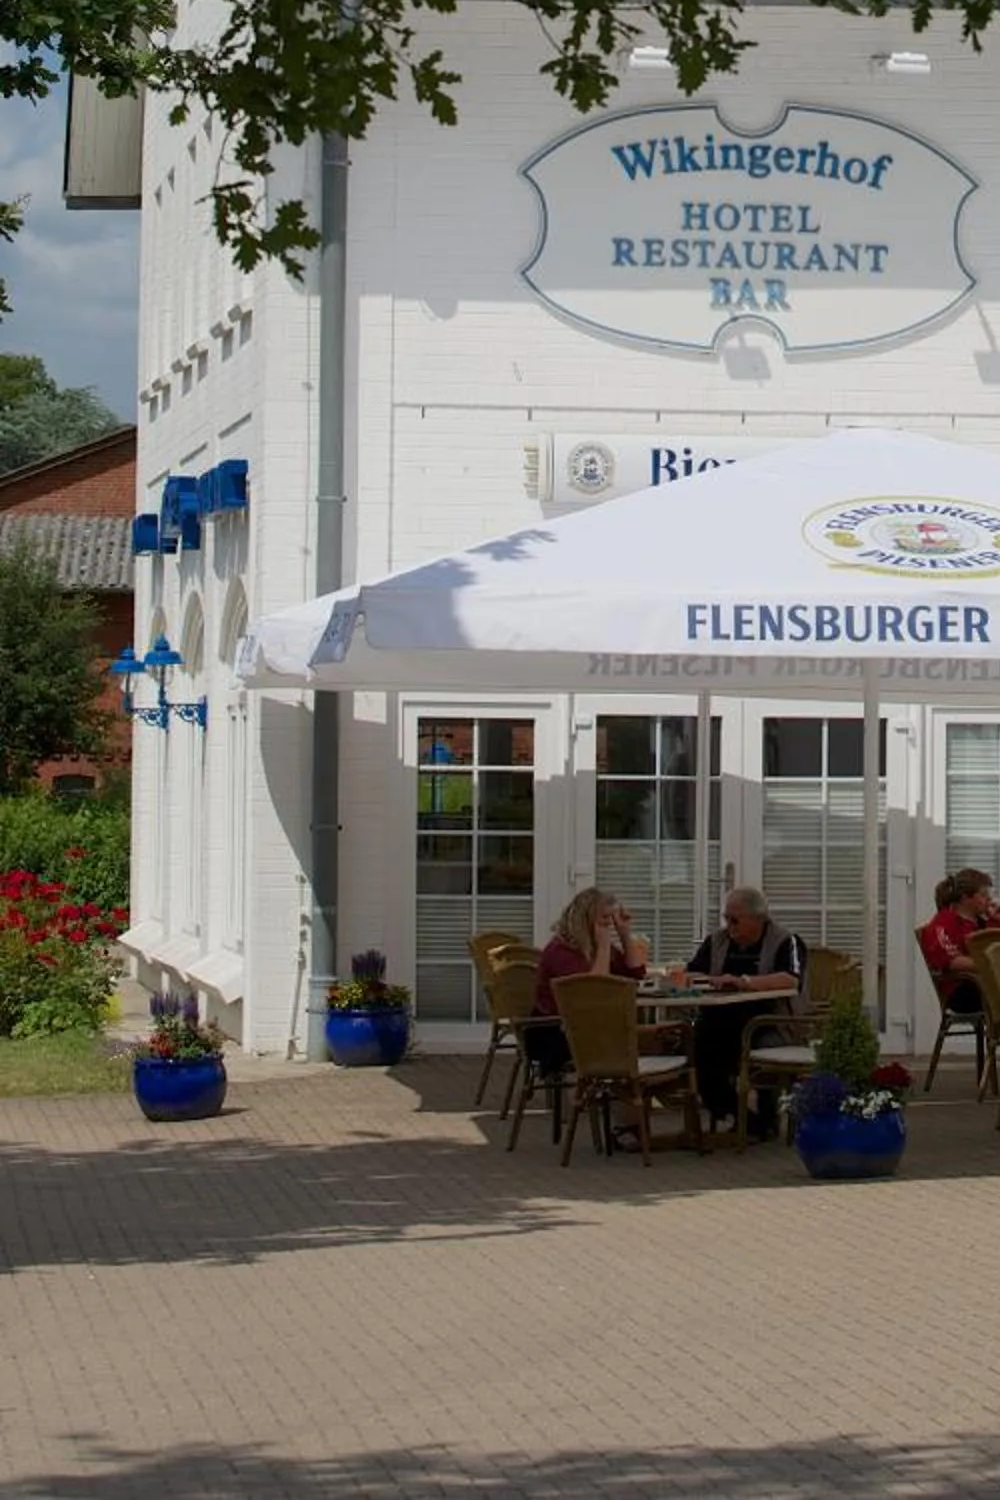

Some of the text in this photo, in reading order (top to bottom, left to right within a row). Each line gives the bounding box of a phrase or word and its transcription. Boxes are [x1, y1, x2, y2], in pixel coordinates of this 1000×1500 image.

[612, 134, 893, 189] Wikingerhof
[681, 202, 821, 233] HOTEL
[611, 237, 889, 273] RESTAURANT
[709, 277, 792, 311] BAR
[687, 604, 990, 643] FLENSBURGER
